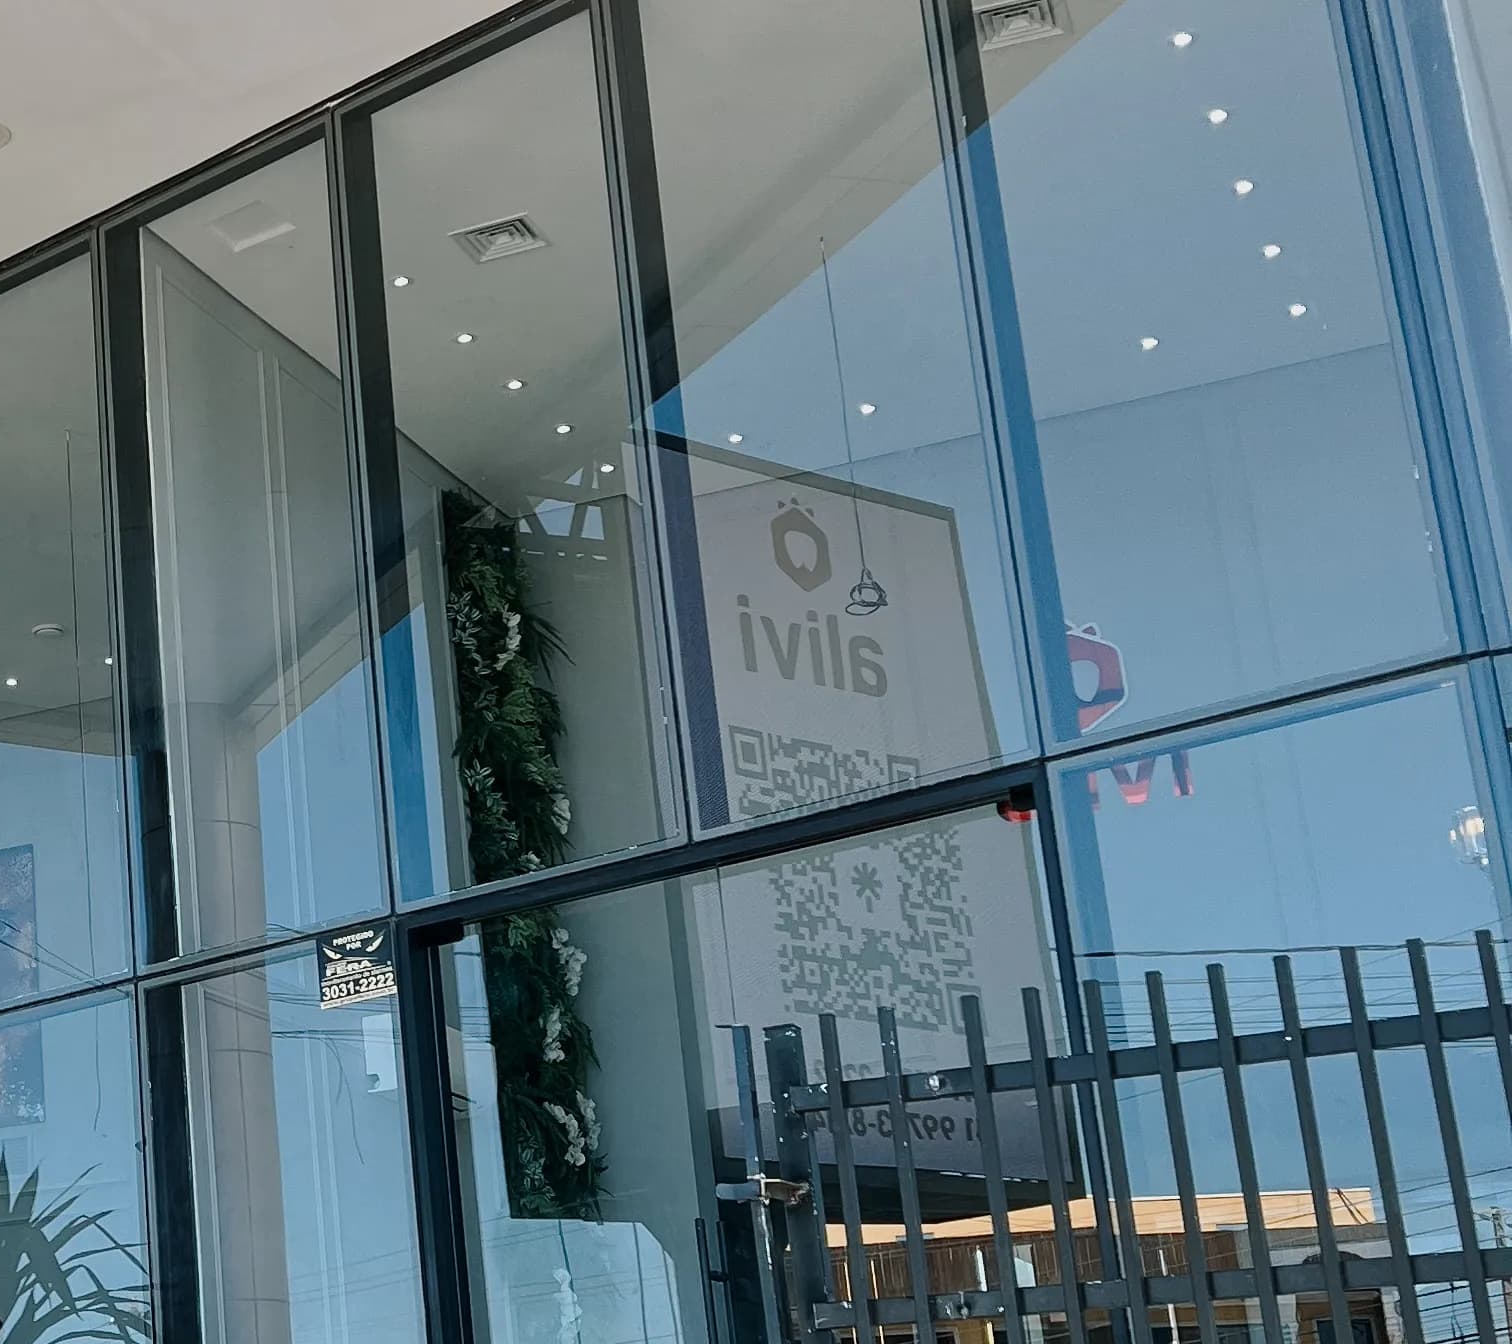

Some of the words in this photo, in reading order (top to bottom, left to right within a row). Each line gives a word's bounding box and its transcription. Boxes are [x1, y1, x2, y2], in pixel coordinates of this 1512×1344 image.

[332, 929, 374, 946] PROTEGIDO
[345, 941, 362, 951] POR
[325, 960, 372, 977] FERA
[322, 972, 395, 1001] 3031-2222
